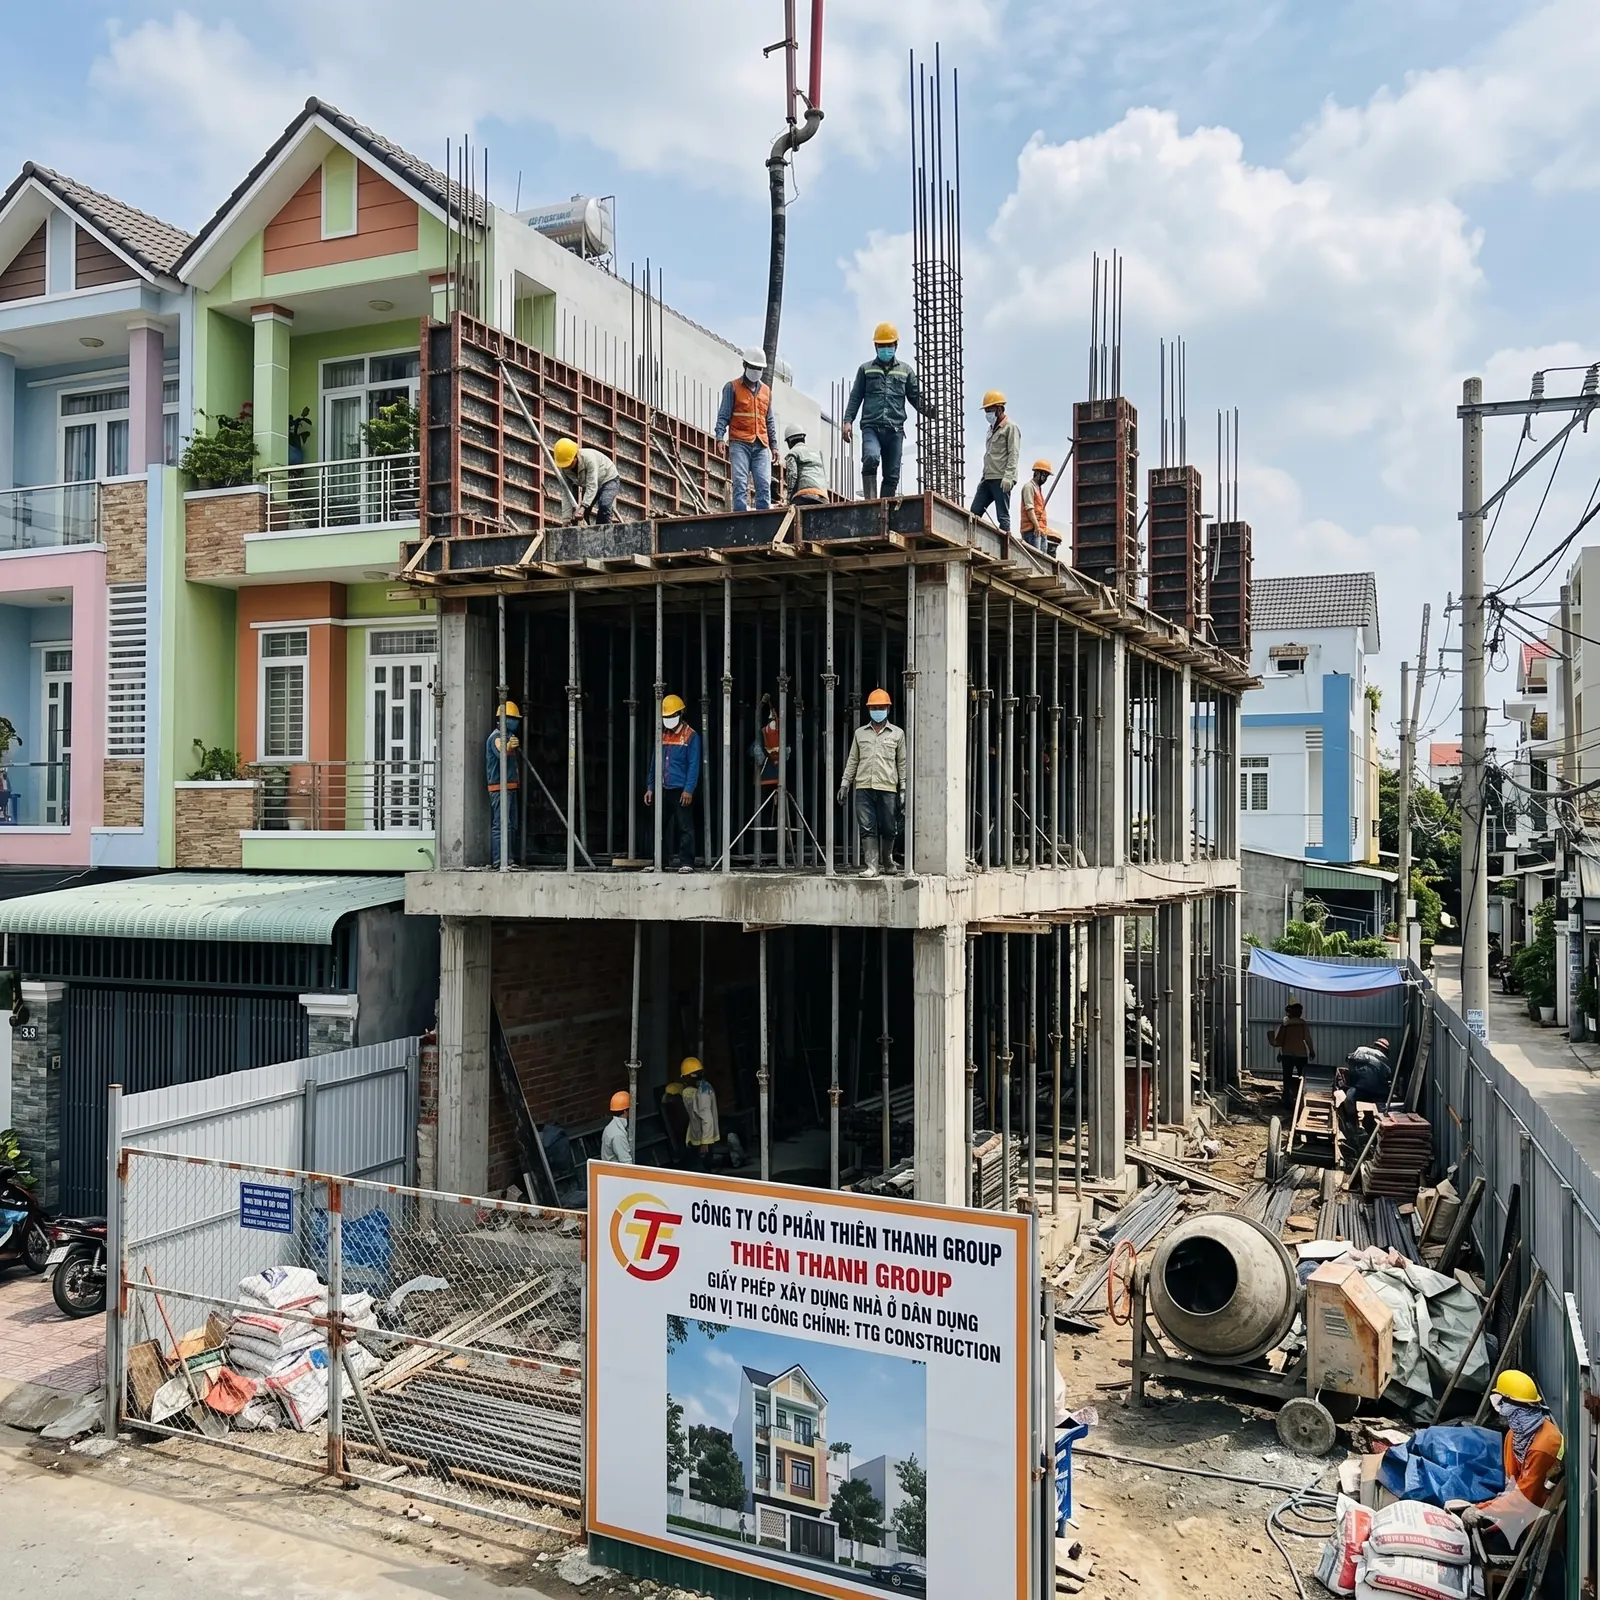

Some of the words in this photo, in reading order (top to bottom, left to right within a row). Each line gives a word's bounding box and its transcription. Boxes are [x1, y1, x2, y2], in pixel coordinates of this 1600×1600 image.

[692, 1199, 731, 1228] CÔNG
[736, 1208, 753, 1231] TY
[758, 1204, 778, 1234] CỔ
[783, 1210, 825, 1241] PHẦN
[831, 1221, 877, 1249] THIÊN
[883, 1229, 937, 1258] THANH
[943, 1237, 1002, 1266] GROUP
[708, 1269, 737, 1291] GIẤY
[741, 1278, 776, 1297] PHÉP
[780, 1282, 806, 1305] XÂY
[811, 1289, 848, 1310] DỰNG
[853, 1295, 882, 1316] NHÀ
[887, 1295, 896, 1318] Ở
[902, 1302, 931, 1324] DÂN
[937, 1309, 978, 1332] DỤNG
[731, 1241, 790, 1272] THIÊN
[797, 1251, 867, 1285] THANH
[876, 1263, 952, 1297] GROUP
[690, 1293, 716, 1312] ĐƠN
[720, 1298, 733, 1319] VỊ
[736, 1301, 757, 1320] THI
[762, 1305, 798, 1327] CÔNG
[803, 1313, 850, 1337] CHÍNH:
[855, 1322, 880, 1342] TTG
[885, 1327, 1000, 1363] CONSTRUCTION
